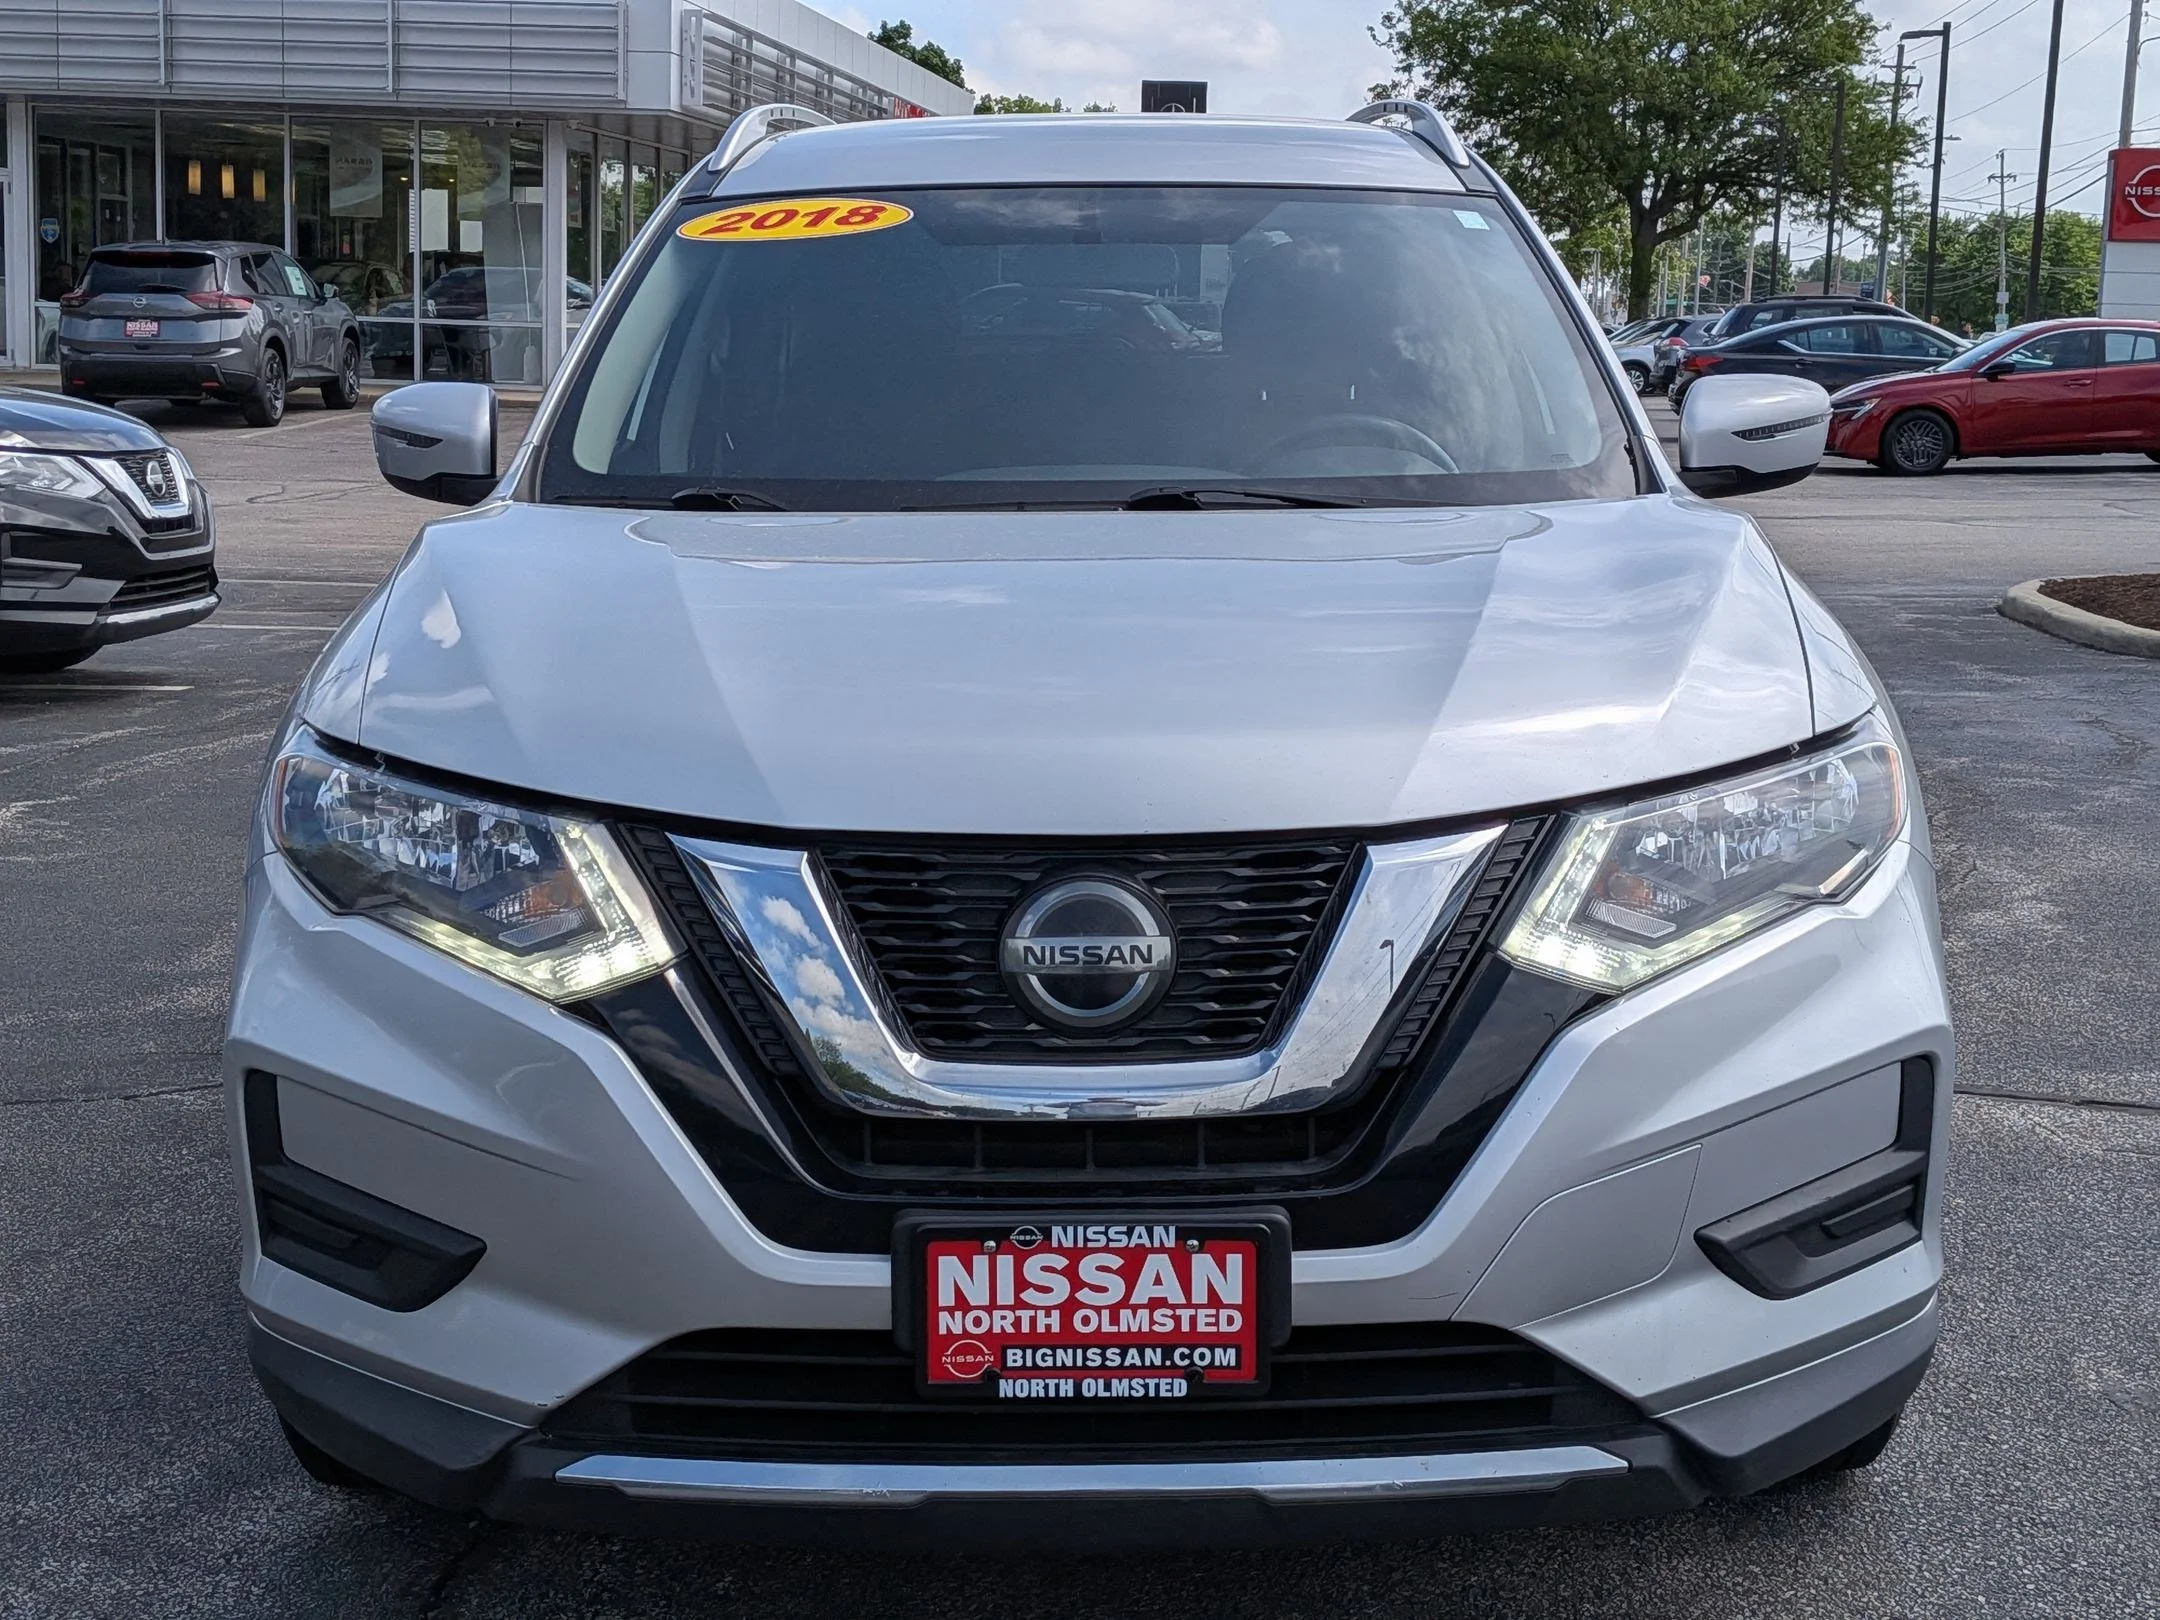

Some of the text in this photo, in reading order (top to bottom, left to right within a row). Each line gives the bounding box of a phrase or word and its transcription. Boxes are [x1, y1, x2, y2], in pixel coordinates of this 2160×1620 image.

[699, 205, 888, 236] 2018
[1023, 944, 1153, 965] NISSAN
[1051, 1225, 1177, 1248] NISSAN
[938, 1253, 1243, 1307] NISSAN
[938, 1308, 1242, 1335] NORTH OLMSTED
[942, 1355, 994, 1363] NISSAN
[1006, 1347, 1237, 1368] BIGNISSAN.COM
[999, 1377, 1188, 1398] NORTH OLMSTED
